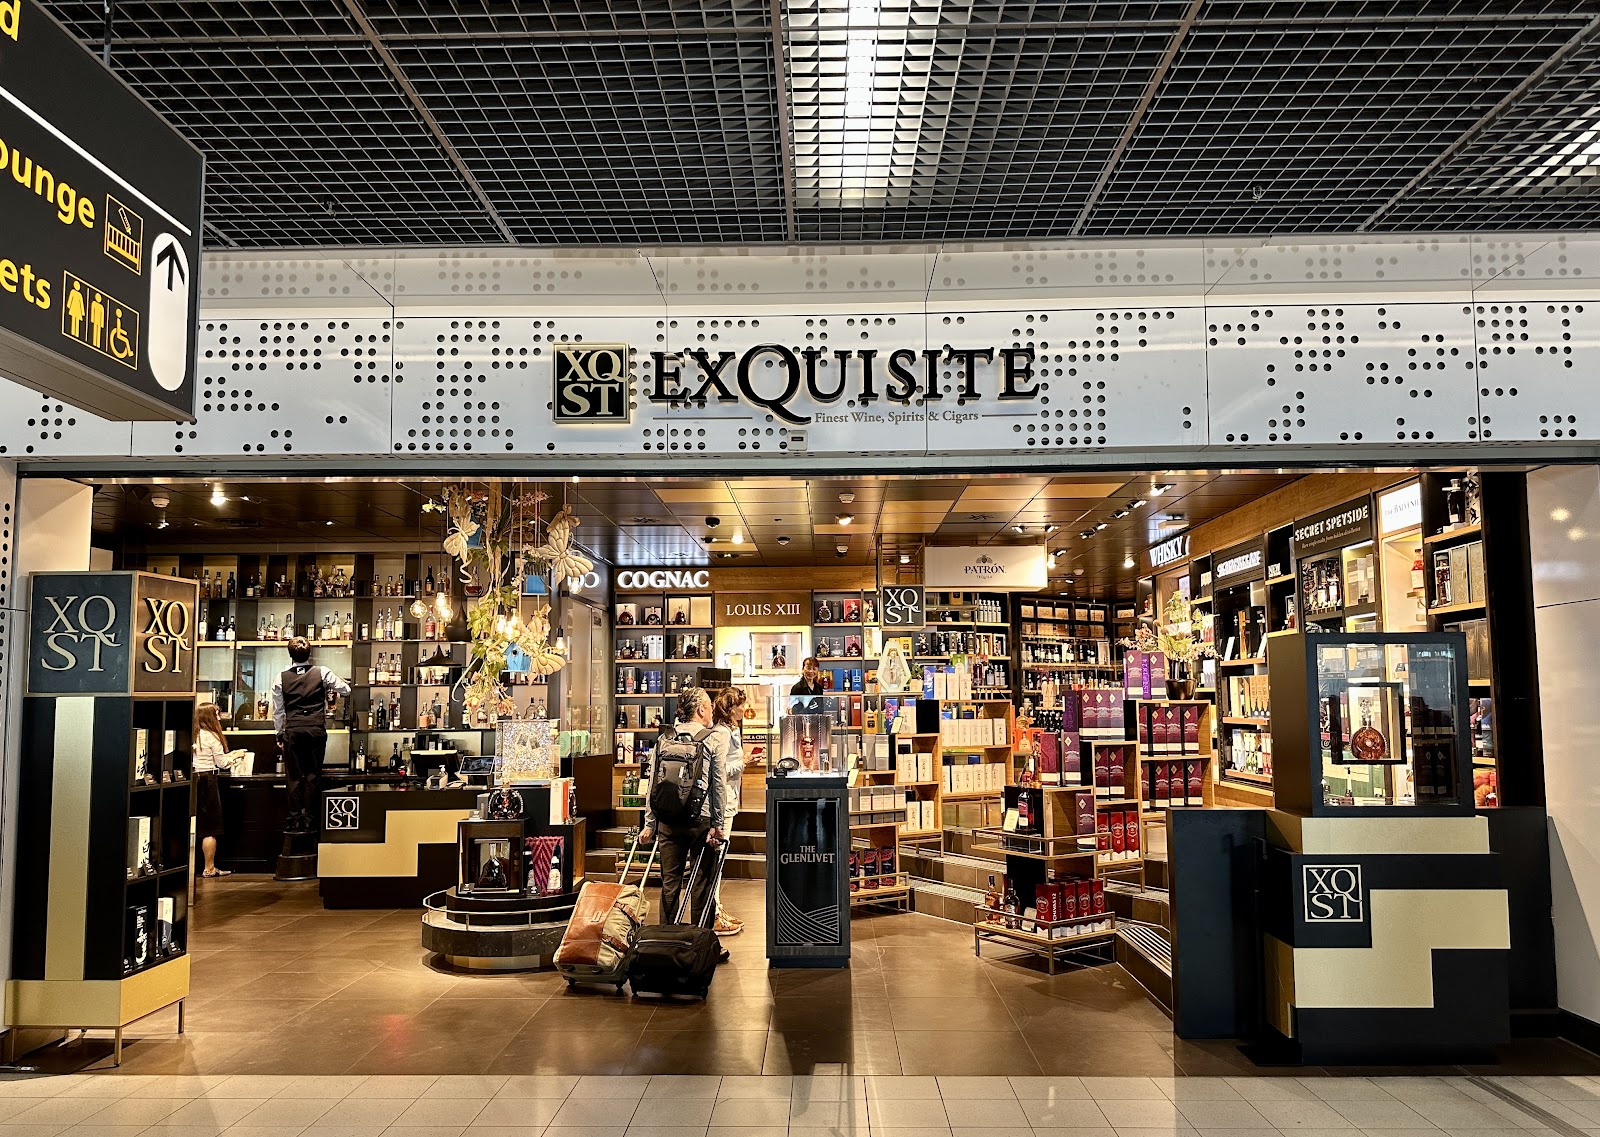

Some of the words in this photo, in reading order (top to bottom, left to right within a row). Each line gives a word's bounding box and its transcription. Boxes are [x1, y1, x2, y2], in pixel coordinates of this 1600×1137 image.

[559, 349, 632, 385] XQ
[649, 342, 1042, 424] EXQUISITE
[561, 384, 620, 415] ST
[815, 413, 849, 423] Finest
[851, 412, 885, 424] Wine,
[888, 411, 925, 425] Spirits
[928, 412, 940, 422] &
[942, 411, 979, 424] Cigars
[1295, 520, 1324, 542] SECRET
[1326, 504, 1369, 532] SPEYSIDE
[1149, 535, 1184, 568] WHISKY
[617, 570, 710, 589] COGNAC
[964, 563, 1006, 574] PATRÓN
[726, 604, 772, 616] LOUIS
[775, 603, 801, 615] XIII
[884, 588, 922, 612] XQ
[43, 595, 122, 647] XQ
[145, 597, 192, 650] XQ
[885, 606, 918, 624] ST
[41, 633, 116, 672] ST
[144, 635, 189, 673] ST
[329, 799, 358, 819] XQ
[329, 814, 352, 828] ST
[780, 852, 835, 865] GLENLIVET
[800, 845, 816, 853] THE
[1309, 868, 1362, 903] XQ
[1310, 893, 1352, 919] ST
